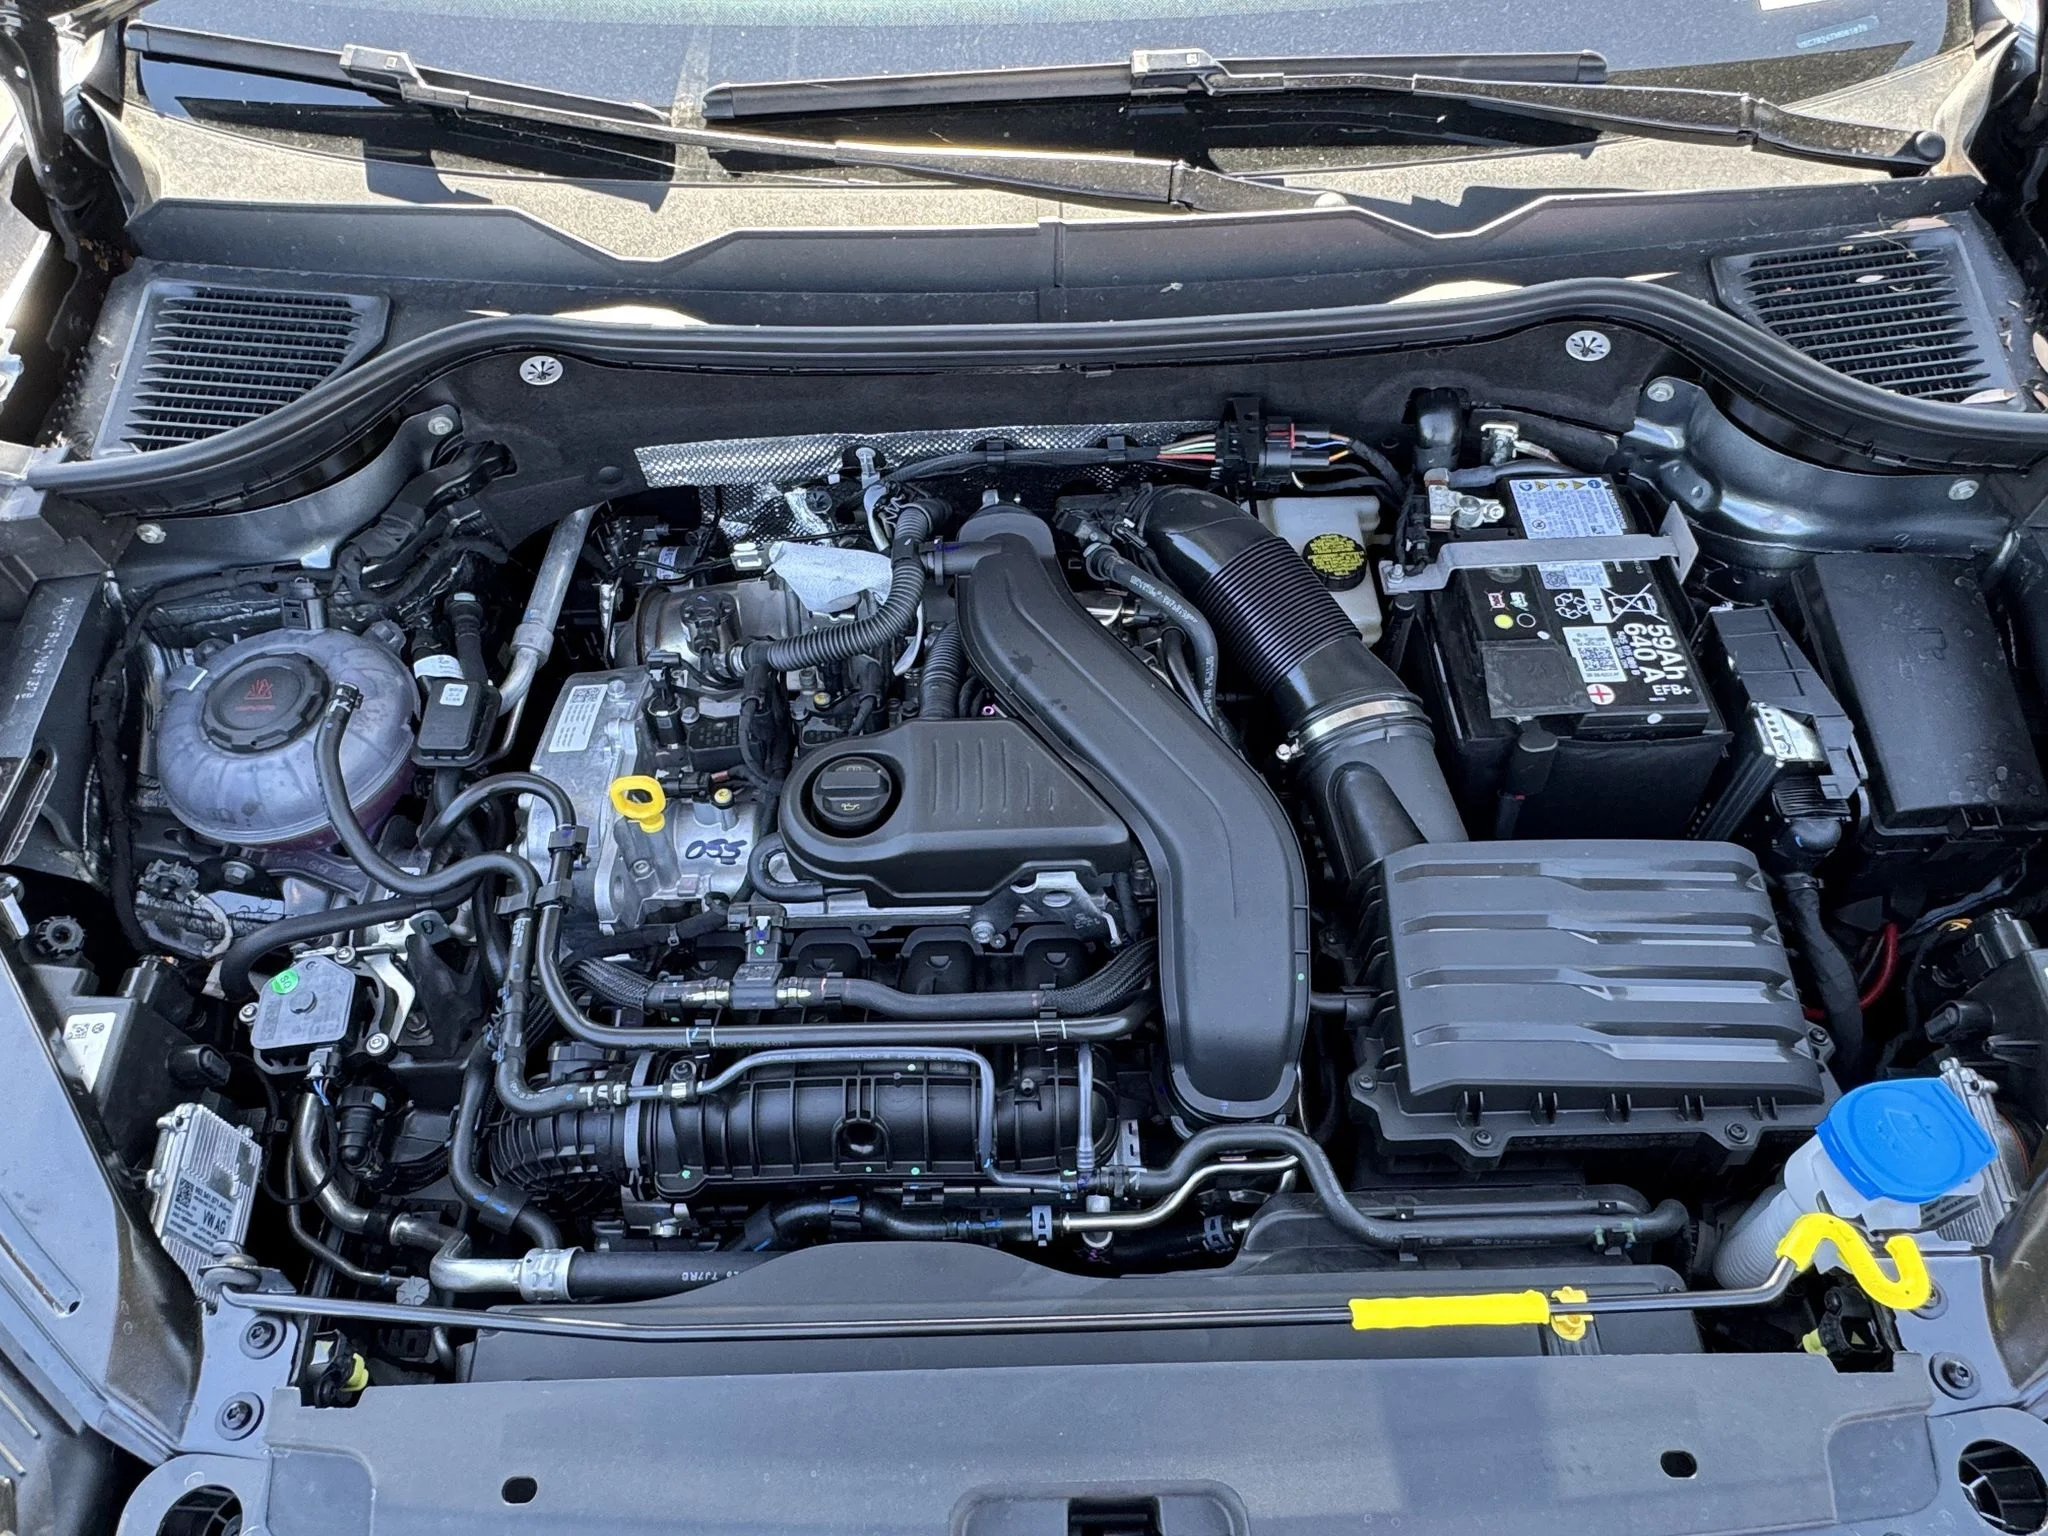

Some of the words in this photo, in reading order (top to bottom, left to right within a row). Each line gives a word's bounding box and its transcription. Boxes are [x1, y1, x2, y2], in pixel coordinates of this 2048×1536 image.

[1590, 598, 1602, 611] Pb
[1623, 623, 1658, 661] 640
[1647, 624, 1687, 680] 59Ah
[1638, 666, 1666, 683] A
[1652, 684, 1692, 695] EFB+
[203, 1209, 216, 1229] VW
[214, 1217, 226, 1235] AG
